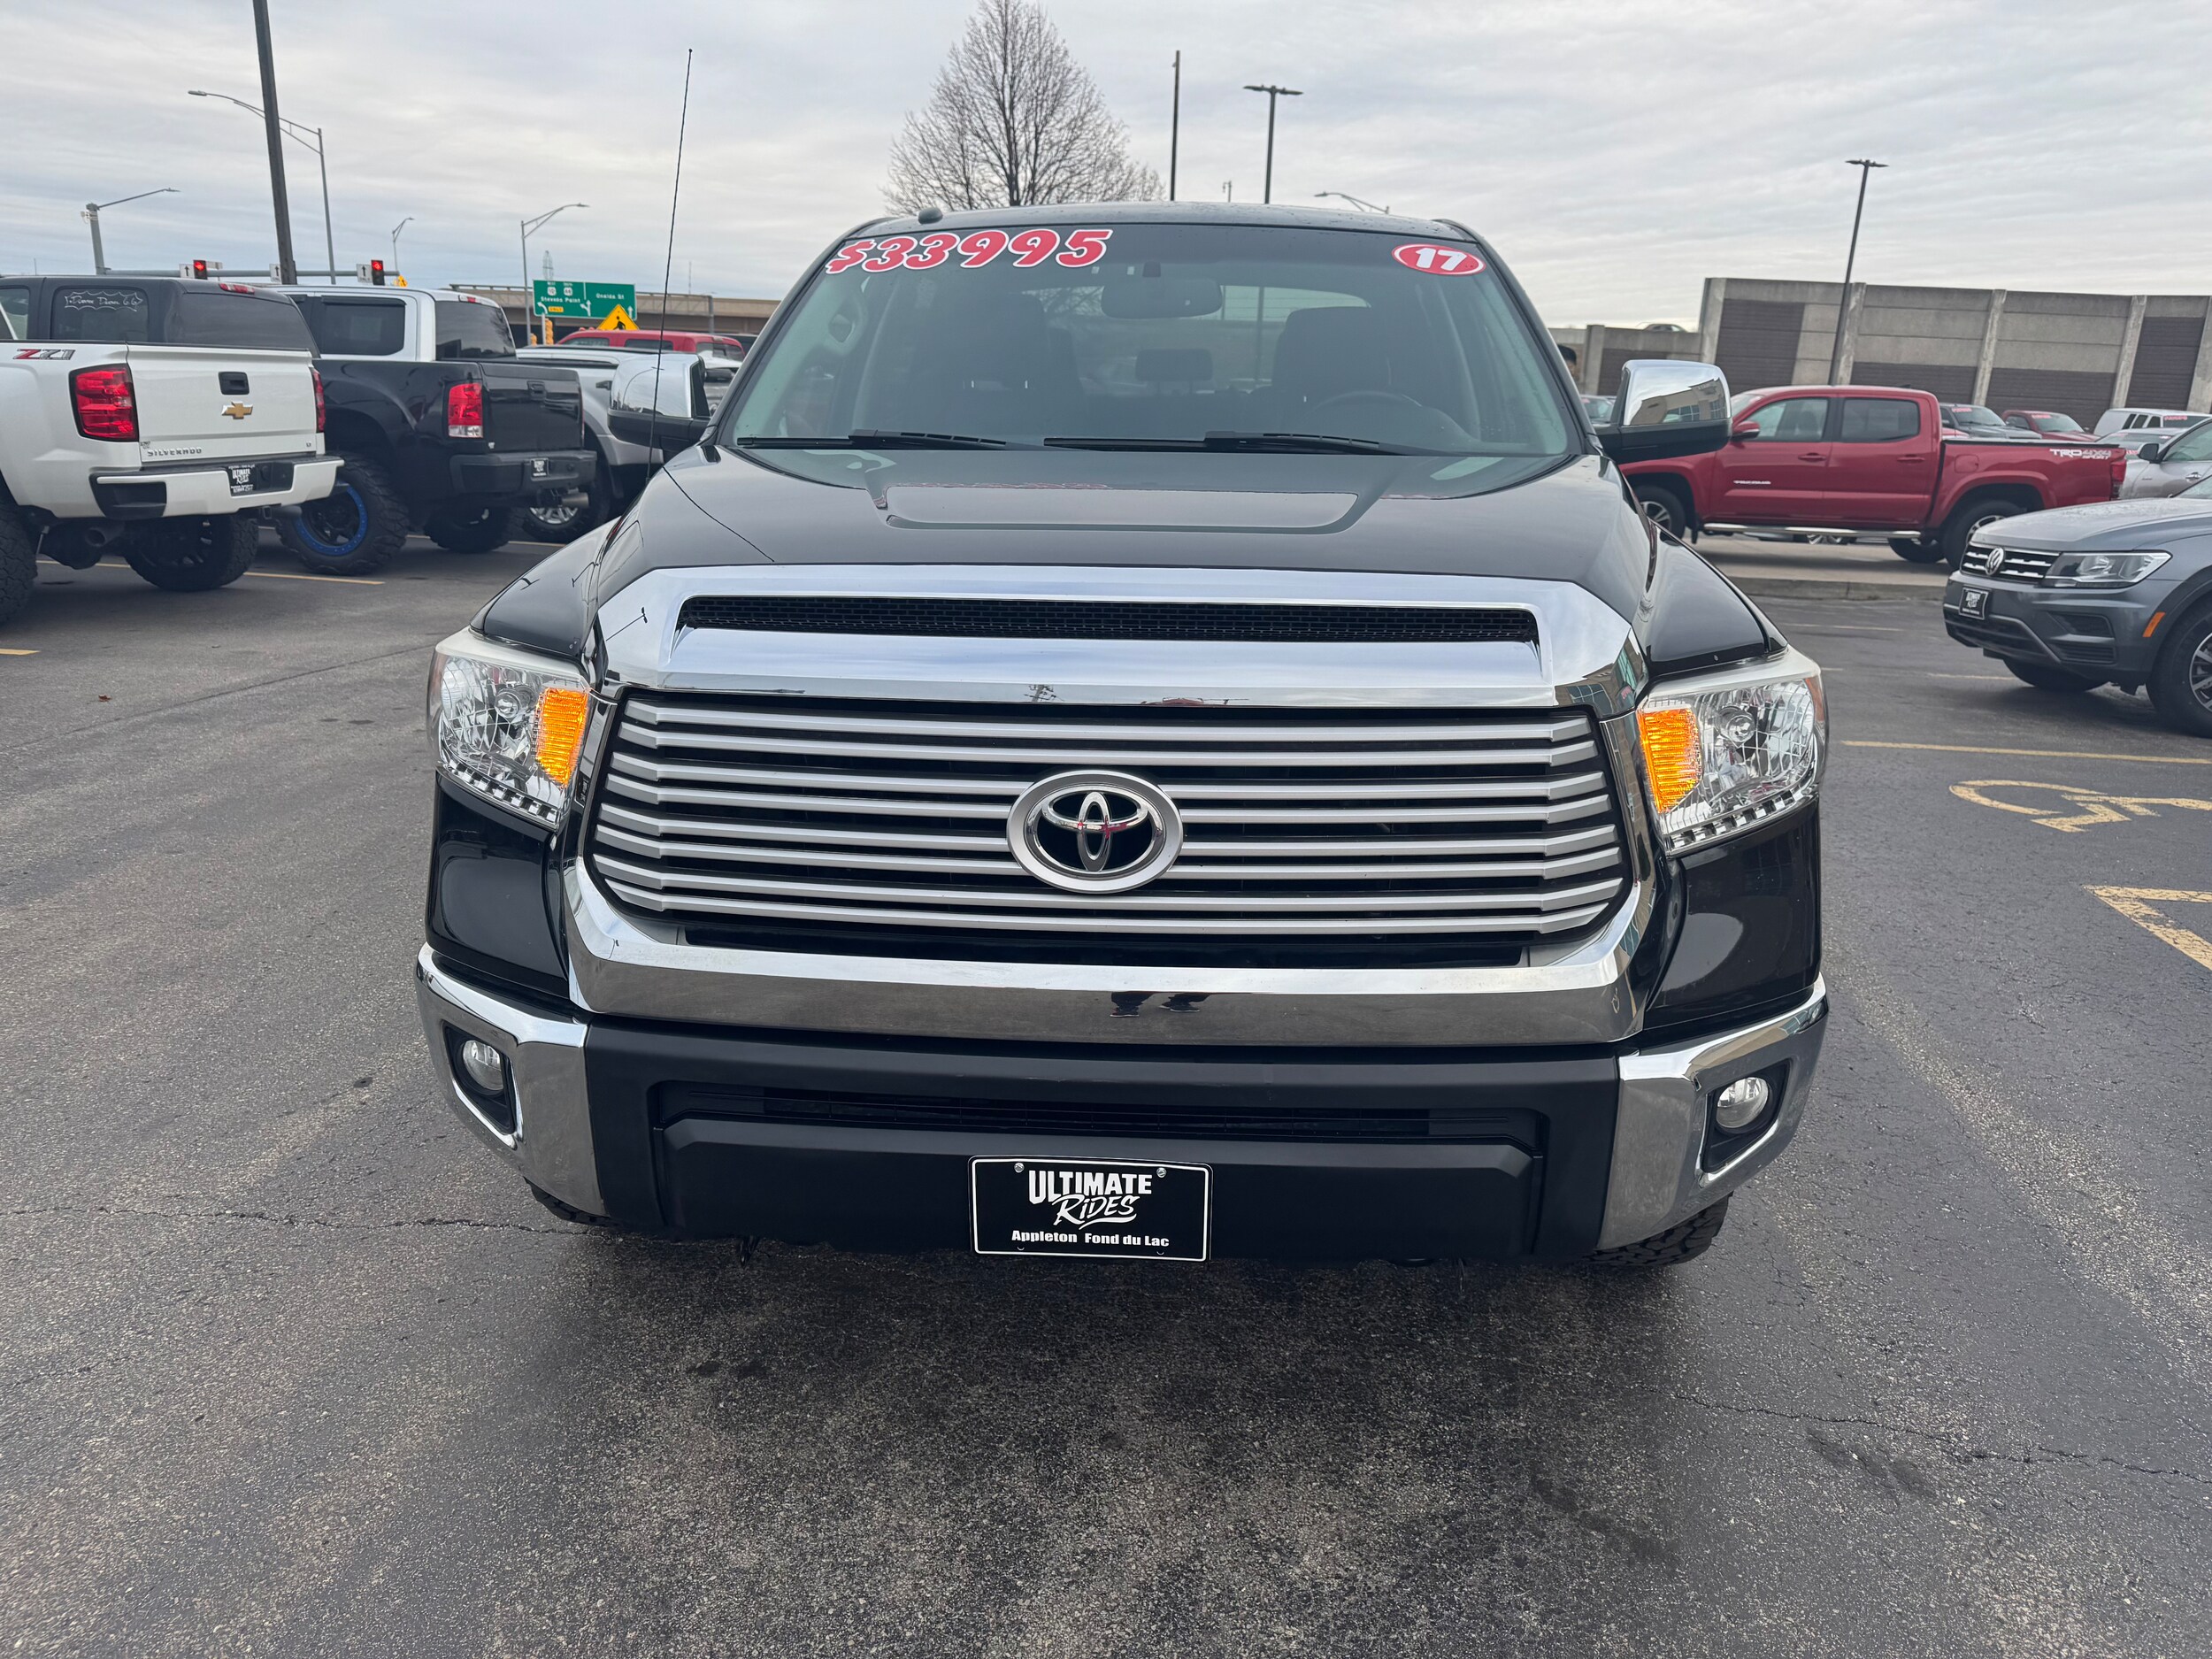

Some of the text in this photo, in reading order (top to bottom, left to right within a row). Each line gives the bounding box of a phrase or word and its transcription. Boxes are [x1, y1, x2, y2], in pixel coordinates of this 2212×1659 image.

[826, 228, 1112, 273] $33995
[1416, 247, 1467, 271] 17
[12, 349, 76, 360] Z71
[147, 447, 203, 457] SILVERADO
[2049, 448, 2083, 458] TRD
[1028, 1170, 1153, 1204] ULTIMATE
[1011, 1230, 1170, 1247] Appleton Fond du Lac
